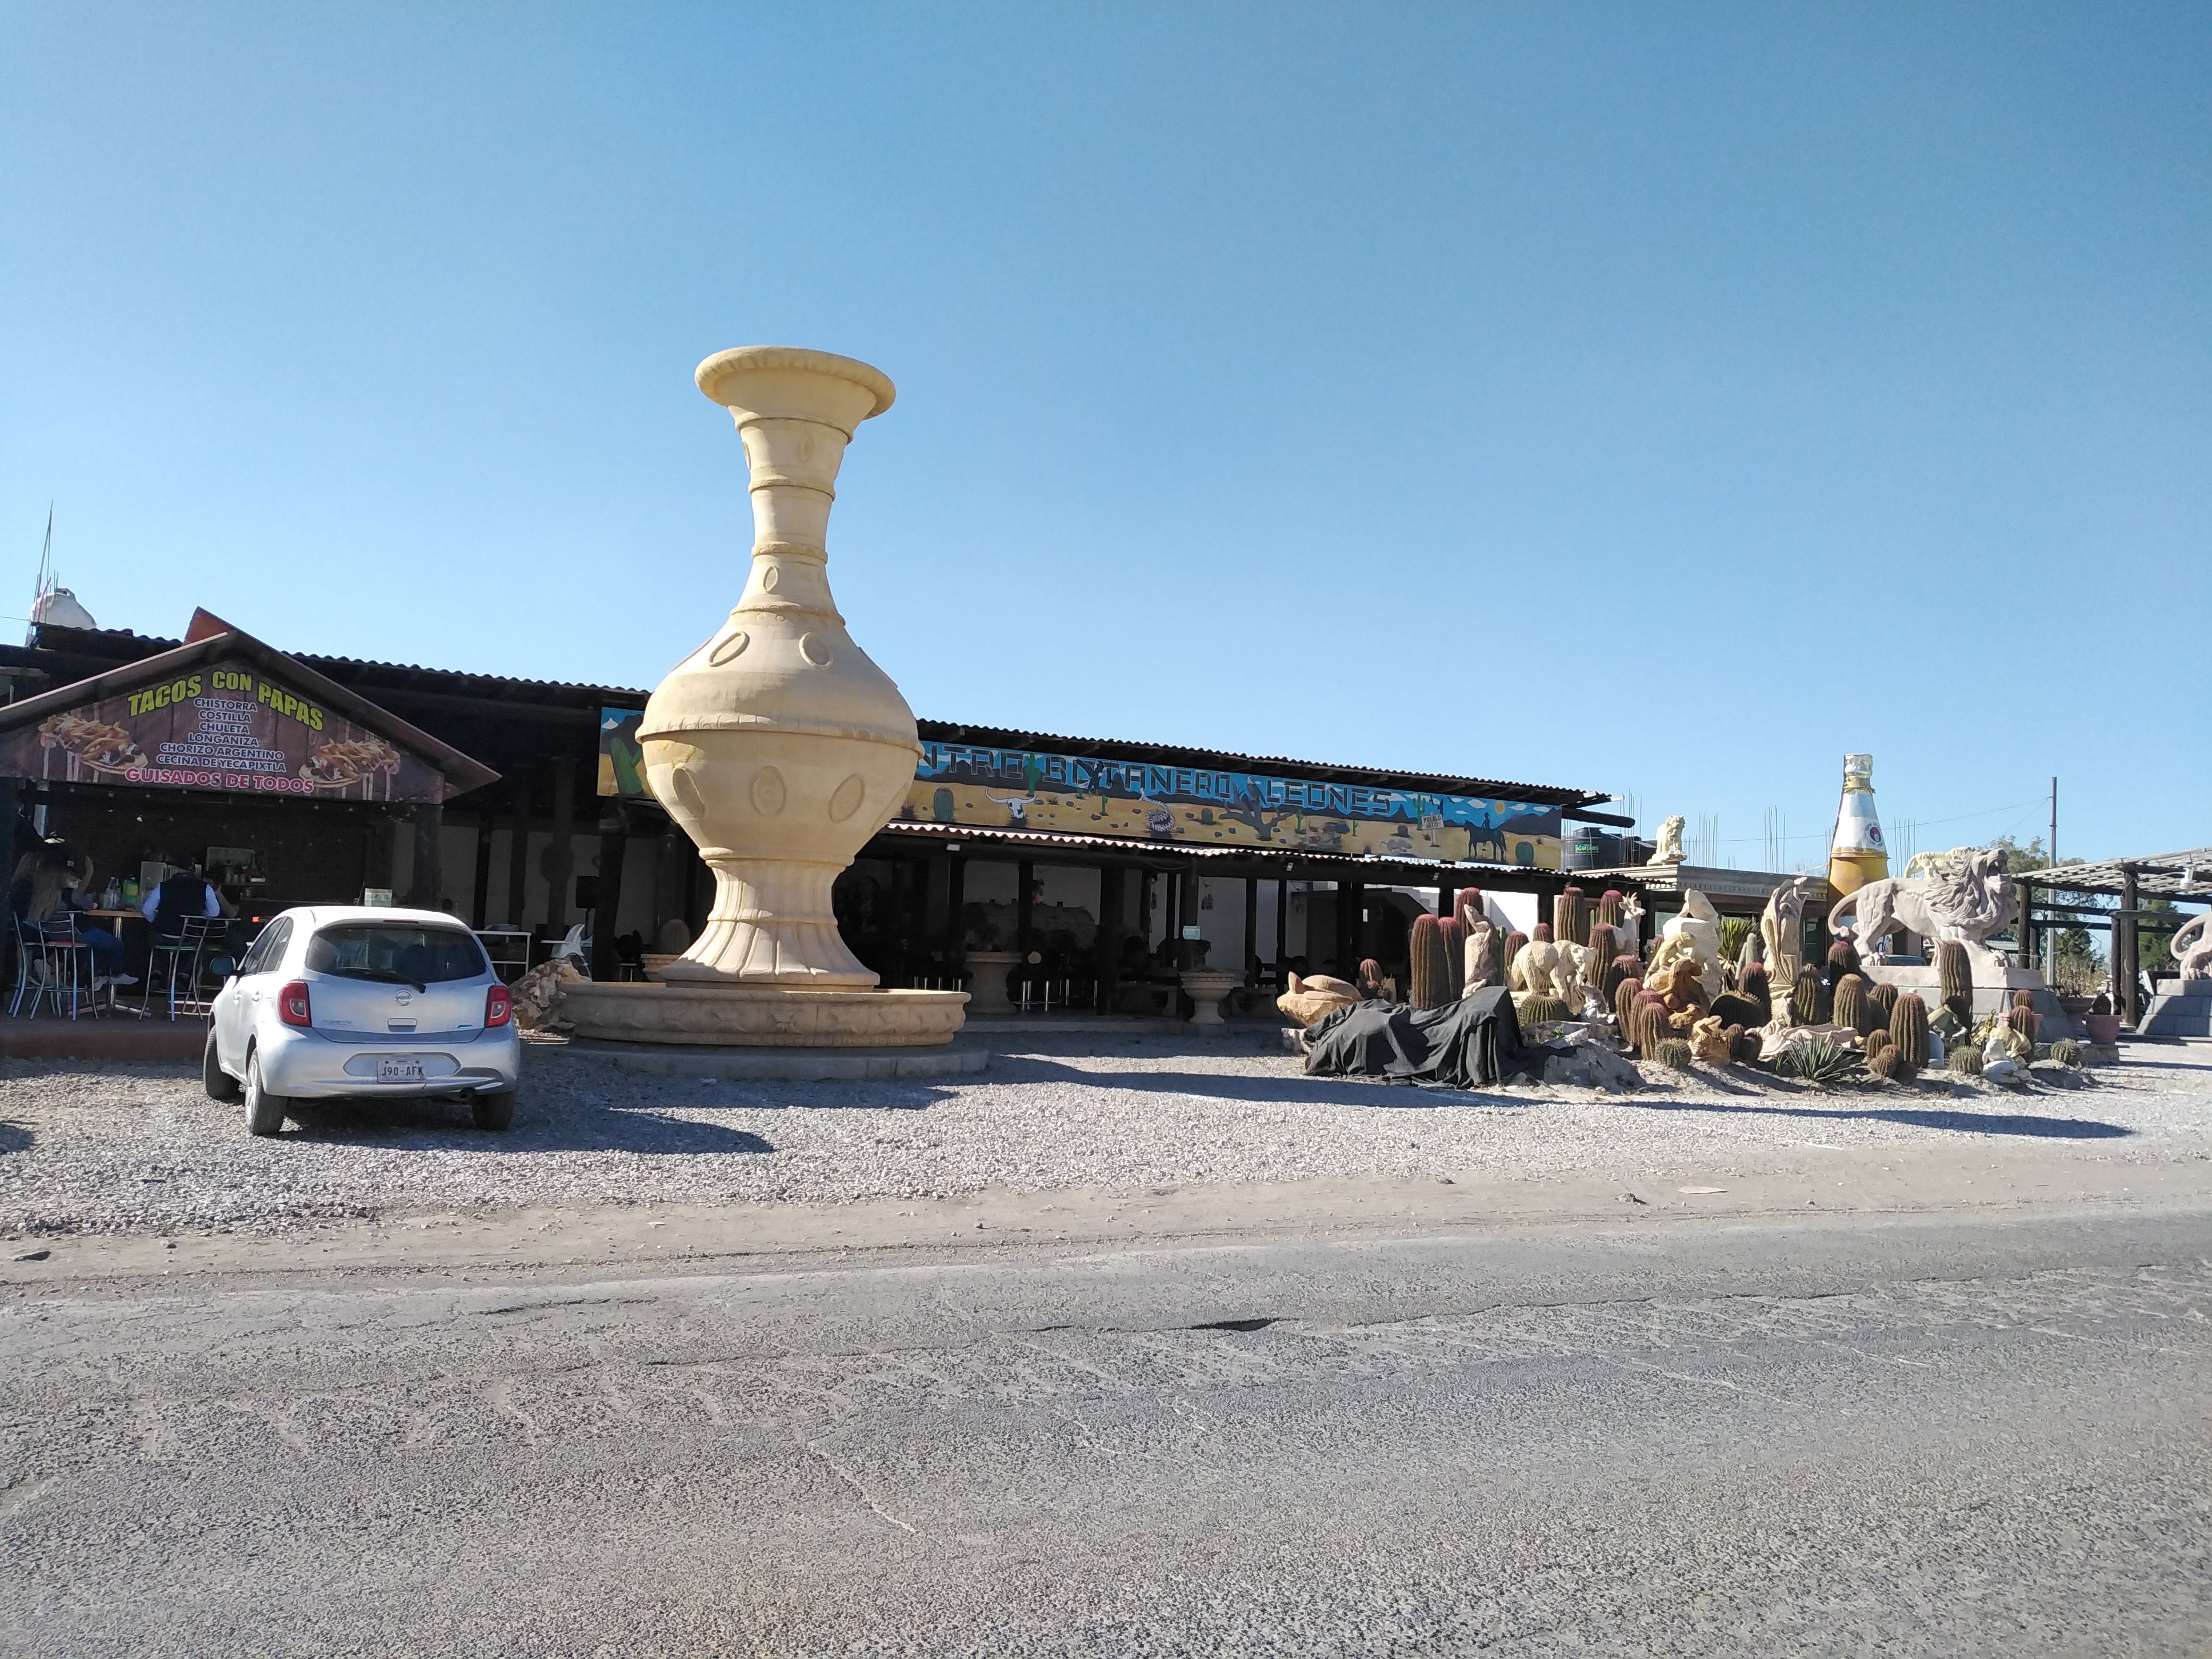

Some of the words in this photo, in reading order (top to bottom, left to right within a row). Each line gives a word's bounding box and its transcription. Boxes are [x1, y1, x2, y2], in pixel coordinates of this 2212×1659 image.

[128, 675, 201, 717] TACOS
[213, 671, 252, 691] CON
[258, 682, 323, 731] PAPAS
[194, 698, 257, 712] CHISTORRA
[199, 710, 252, 723] COSTILLA
[199, 723, 250, 735] CHULETA
[188, 733, 259, 747] LONGANIZA
[160, 742, 214, 755] CHORIZO
[216, 747, 284, 760] ARGENTINO
[156, 754, 199, 767] CECINA
[202, 757, 217, 767] DE
[219, 758, 286, 772] YECAPIXTLA
[125, 767, 221, 786] GUISADOS
[226, 774, 249, 788] DE
[253, 775, 314, 793] TODOS
[917, 744, 1024, 780] NTRO
[1267, 778, 1392, 815] LEONES
[381, 1066, 423, 1076] J90-AFK
